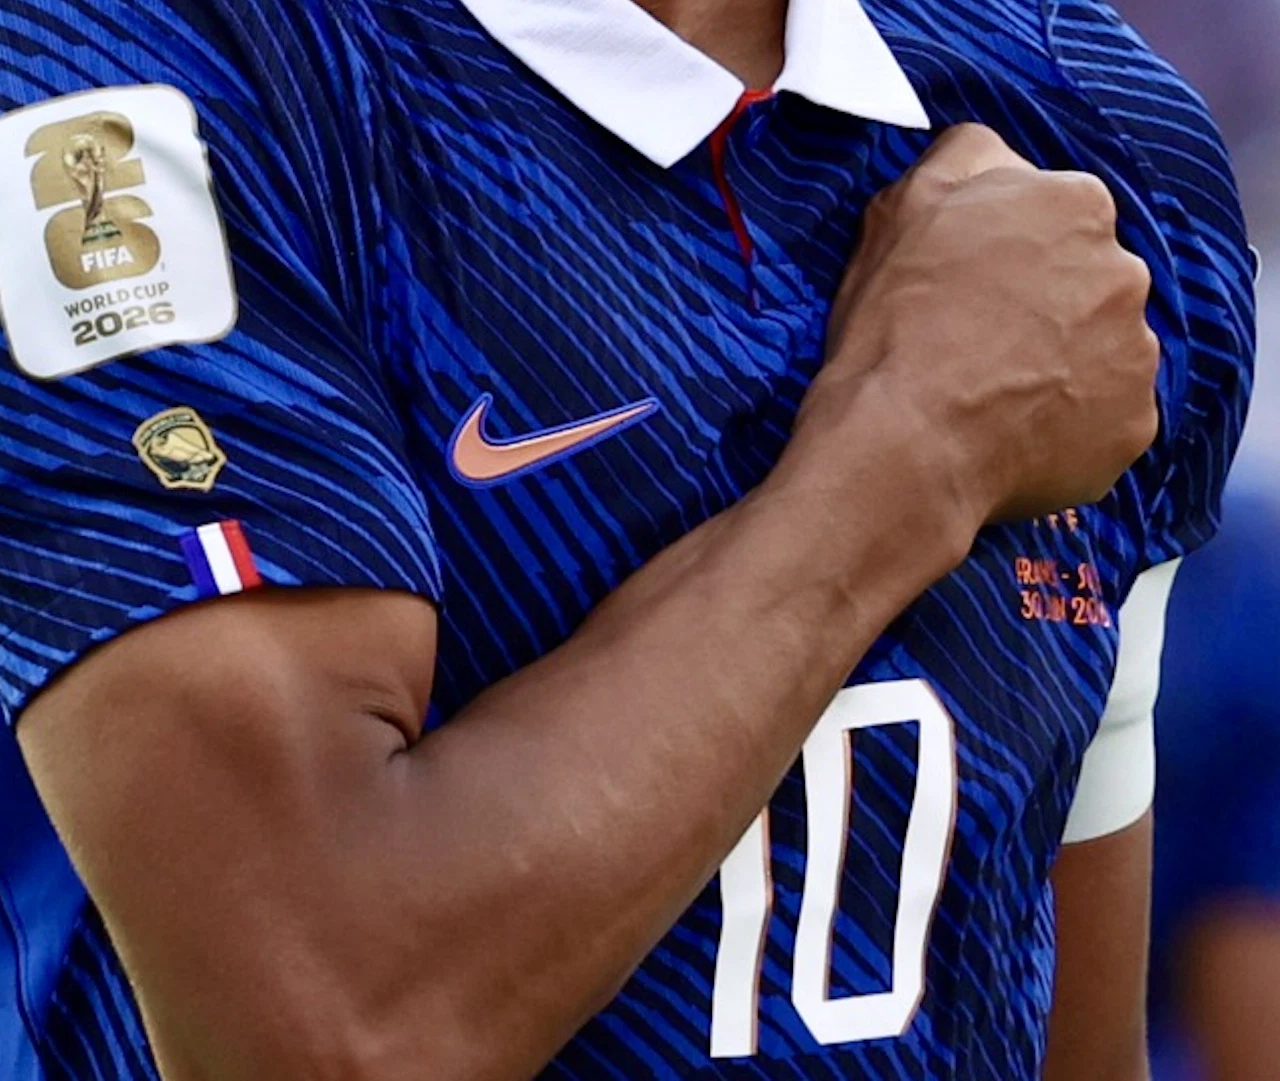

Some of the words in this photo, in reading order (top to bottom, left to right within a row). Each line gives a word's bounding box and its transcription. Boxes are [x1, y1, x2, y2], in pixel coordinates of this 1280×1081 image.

[81, 245, 135, 273] FIFA
[64, 289, 130, 318] WORLD
[133, 281, 170, 300] CUP
[71, 302, 176, 347] 2026
[710, 678, 958, 1058] 10
